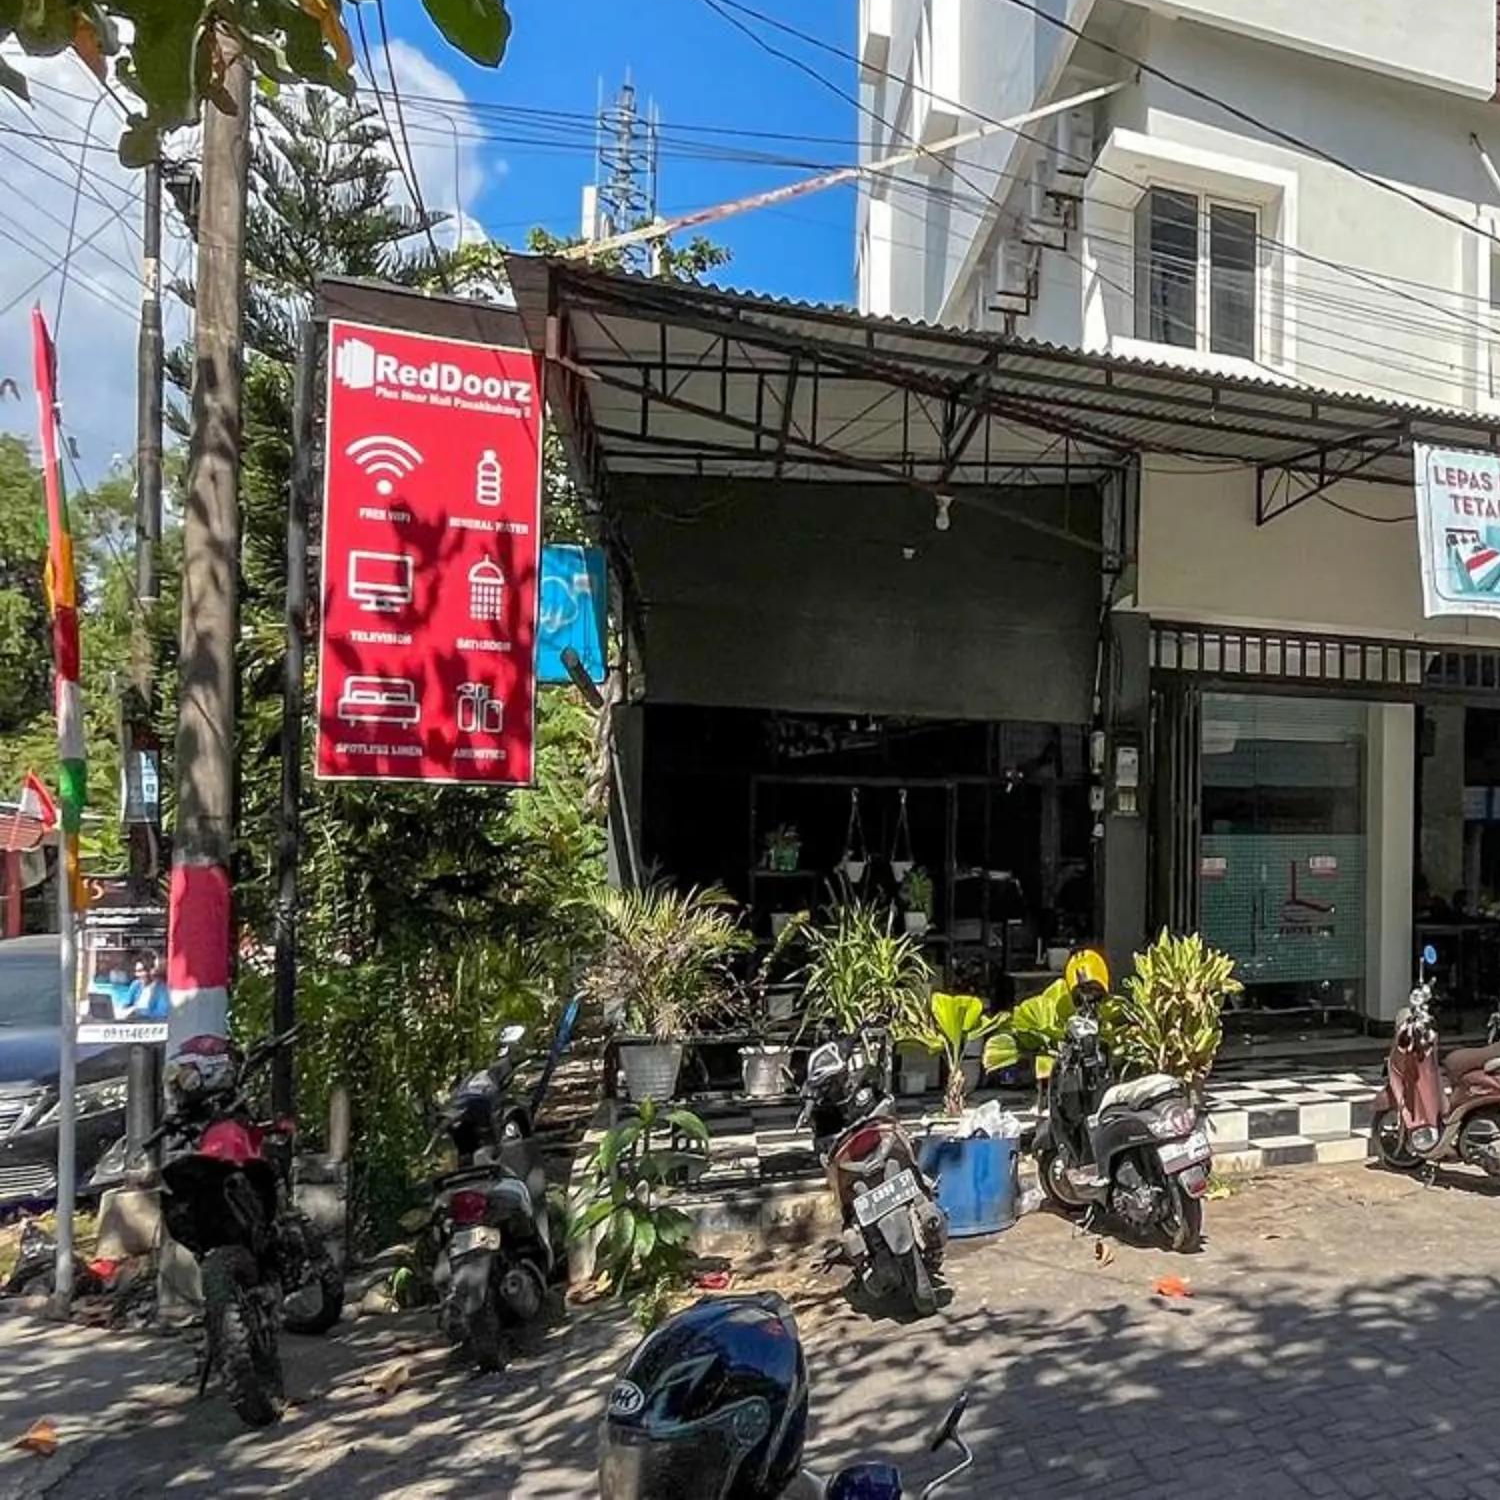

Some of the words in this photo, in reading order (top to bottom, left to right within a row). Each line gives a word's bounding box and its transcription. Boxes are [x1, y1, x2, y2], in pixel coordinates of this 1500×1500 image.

[375, 354, 532, 403] RedDoorz
[1433, 464, 1492, 494] LEPAS
[359, 507, 386, 521] FREE
[350, 630, 412, 645] TELEVISION
